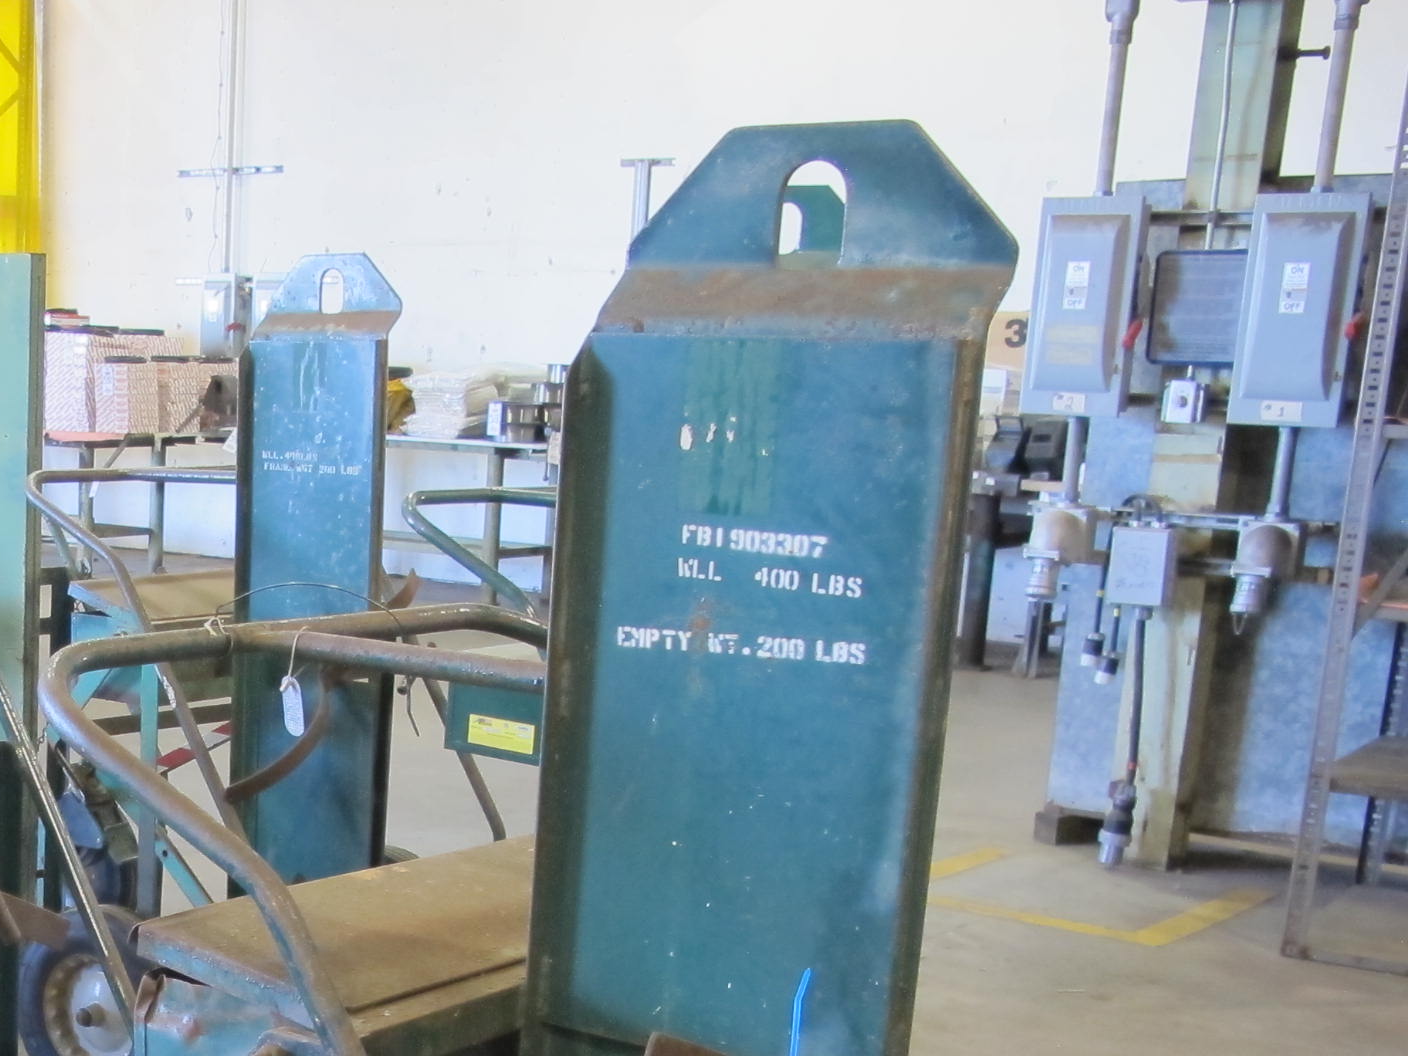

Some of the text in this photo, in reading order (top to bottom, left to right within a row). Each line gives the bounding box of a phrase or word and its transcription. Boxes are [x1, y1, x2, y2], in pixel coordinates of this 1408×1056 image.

[1291, 265, 1305, 274] ON
[1004, 318, 1029, 348] 3
[677, 556, 864, 599] WLL 400 LBS
[616, 625, 693, 652] EMPTY
[814, 639, 867, 665] LBS
